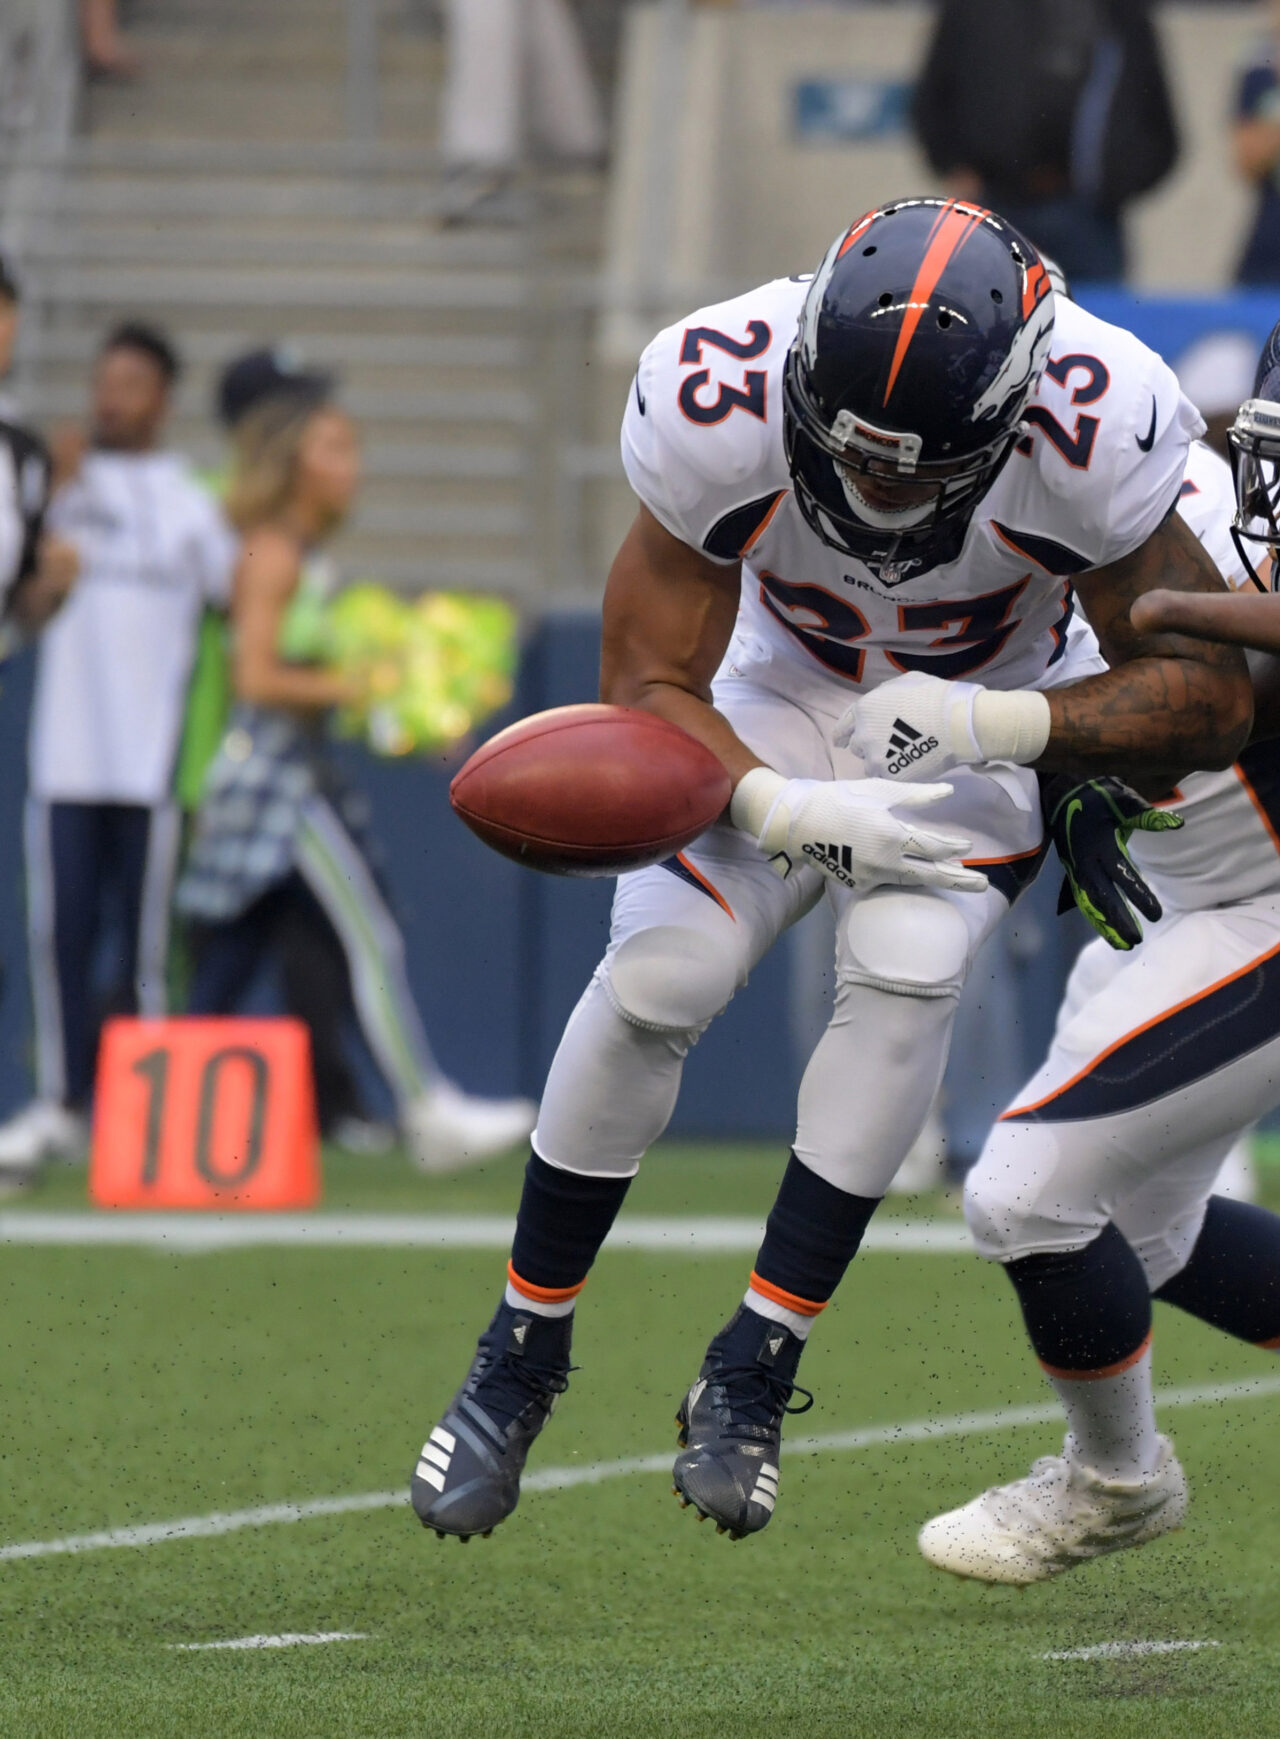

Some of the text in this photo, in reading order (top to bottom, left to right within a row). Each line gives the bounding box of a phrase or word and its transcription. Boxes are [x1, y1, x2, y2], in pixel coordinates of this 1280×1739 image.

[677, 320, 772, 426] 23
[1013, 353, 1111, 471] 23
[759, 570, 1033, 684] 23
[887, 736, 939, 775] adidas
[801, 843, 857, 888] adidas
[132, 1046, 269, 1189] 10
